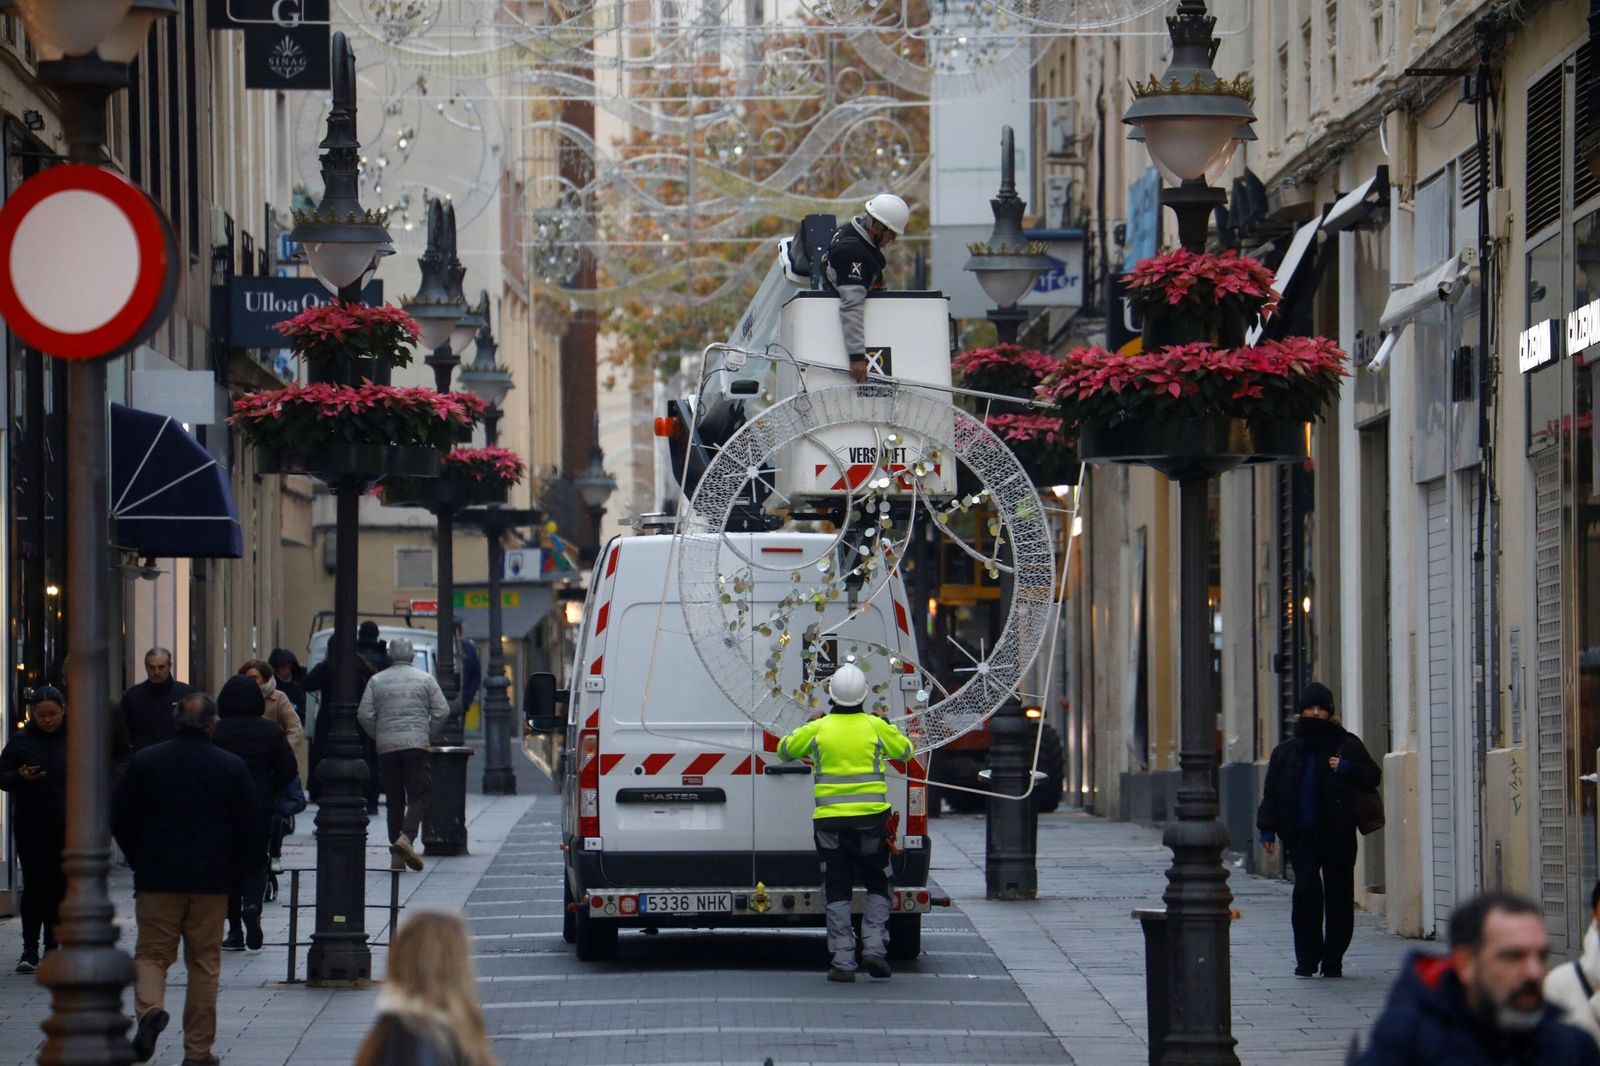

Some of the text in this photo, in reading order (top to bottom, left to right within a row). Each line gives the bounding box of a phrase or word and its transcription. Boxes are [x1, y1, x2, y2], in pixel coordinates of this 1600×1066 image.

[244, 291, 298, 312] Ulloa
[849, 447, 906, 463] VERSIFT
[648, 895, 727, 911] 5336 NHK
